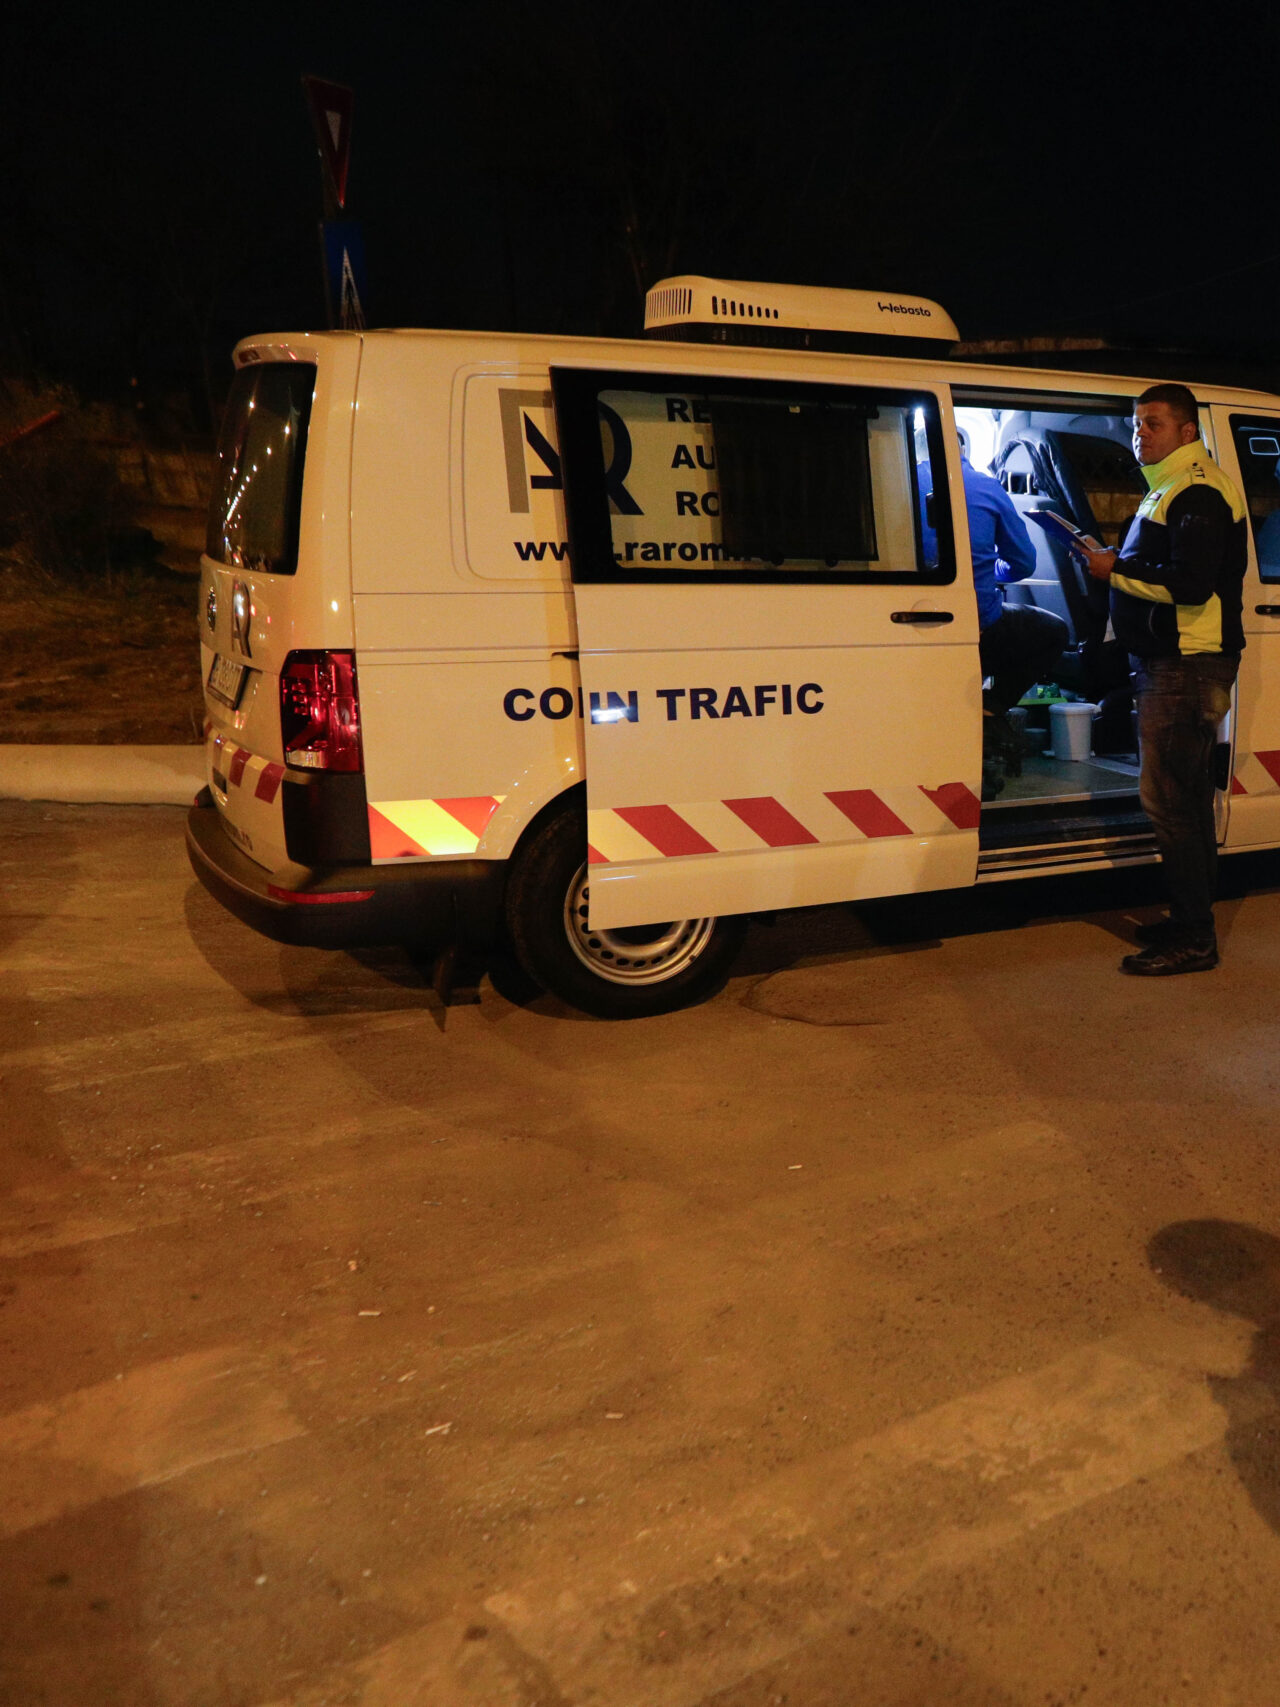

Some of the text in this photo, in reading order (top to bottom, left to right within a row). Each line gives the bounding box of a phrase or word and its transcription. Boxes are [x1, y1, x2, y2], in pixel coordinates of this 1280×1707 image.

[877, 301, 931, 317] Webasto
[671, 444, 716, 469] AU
[676, 491, 720, 516] RO
[656, 682, 824, 721] TRAFIC
